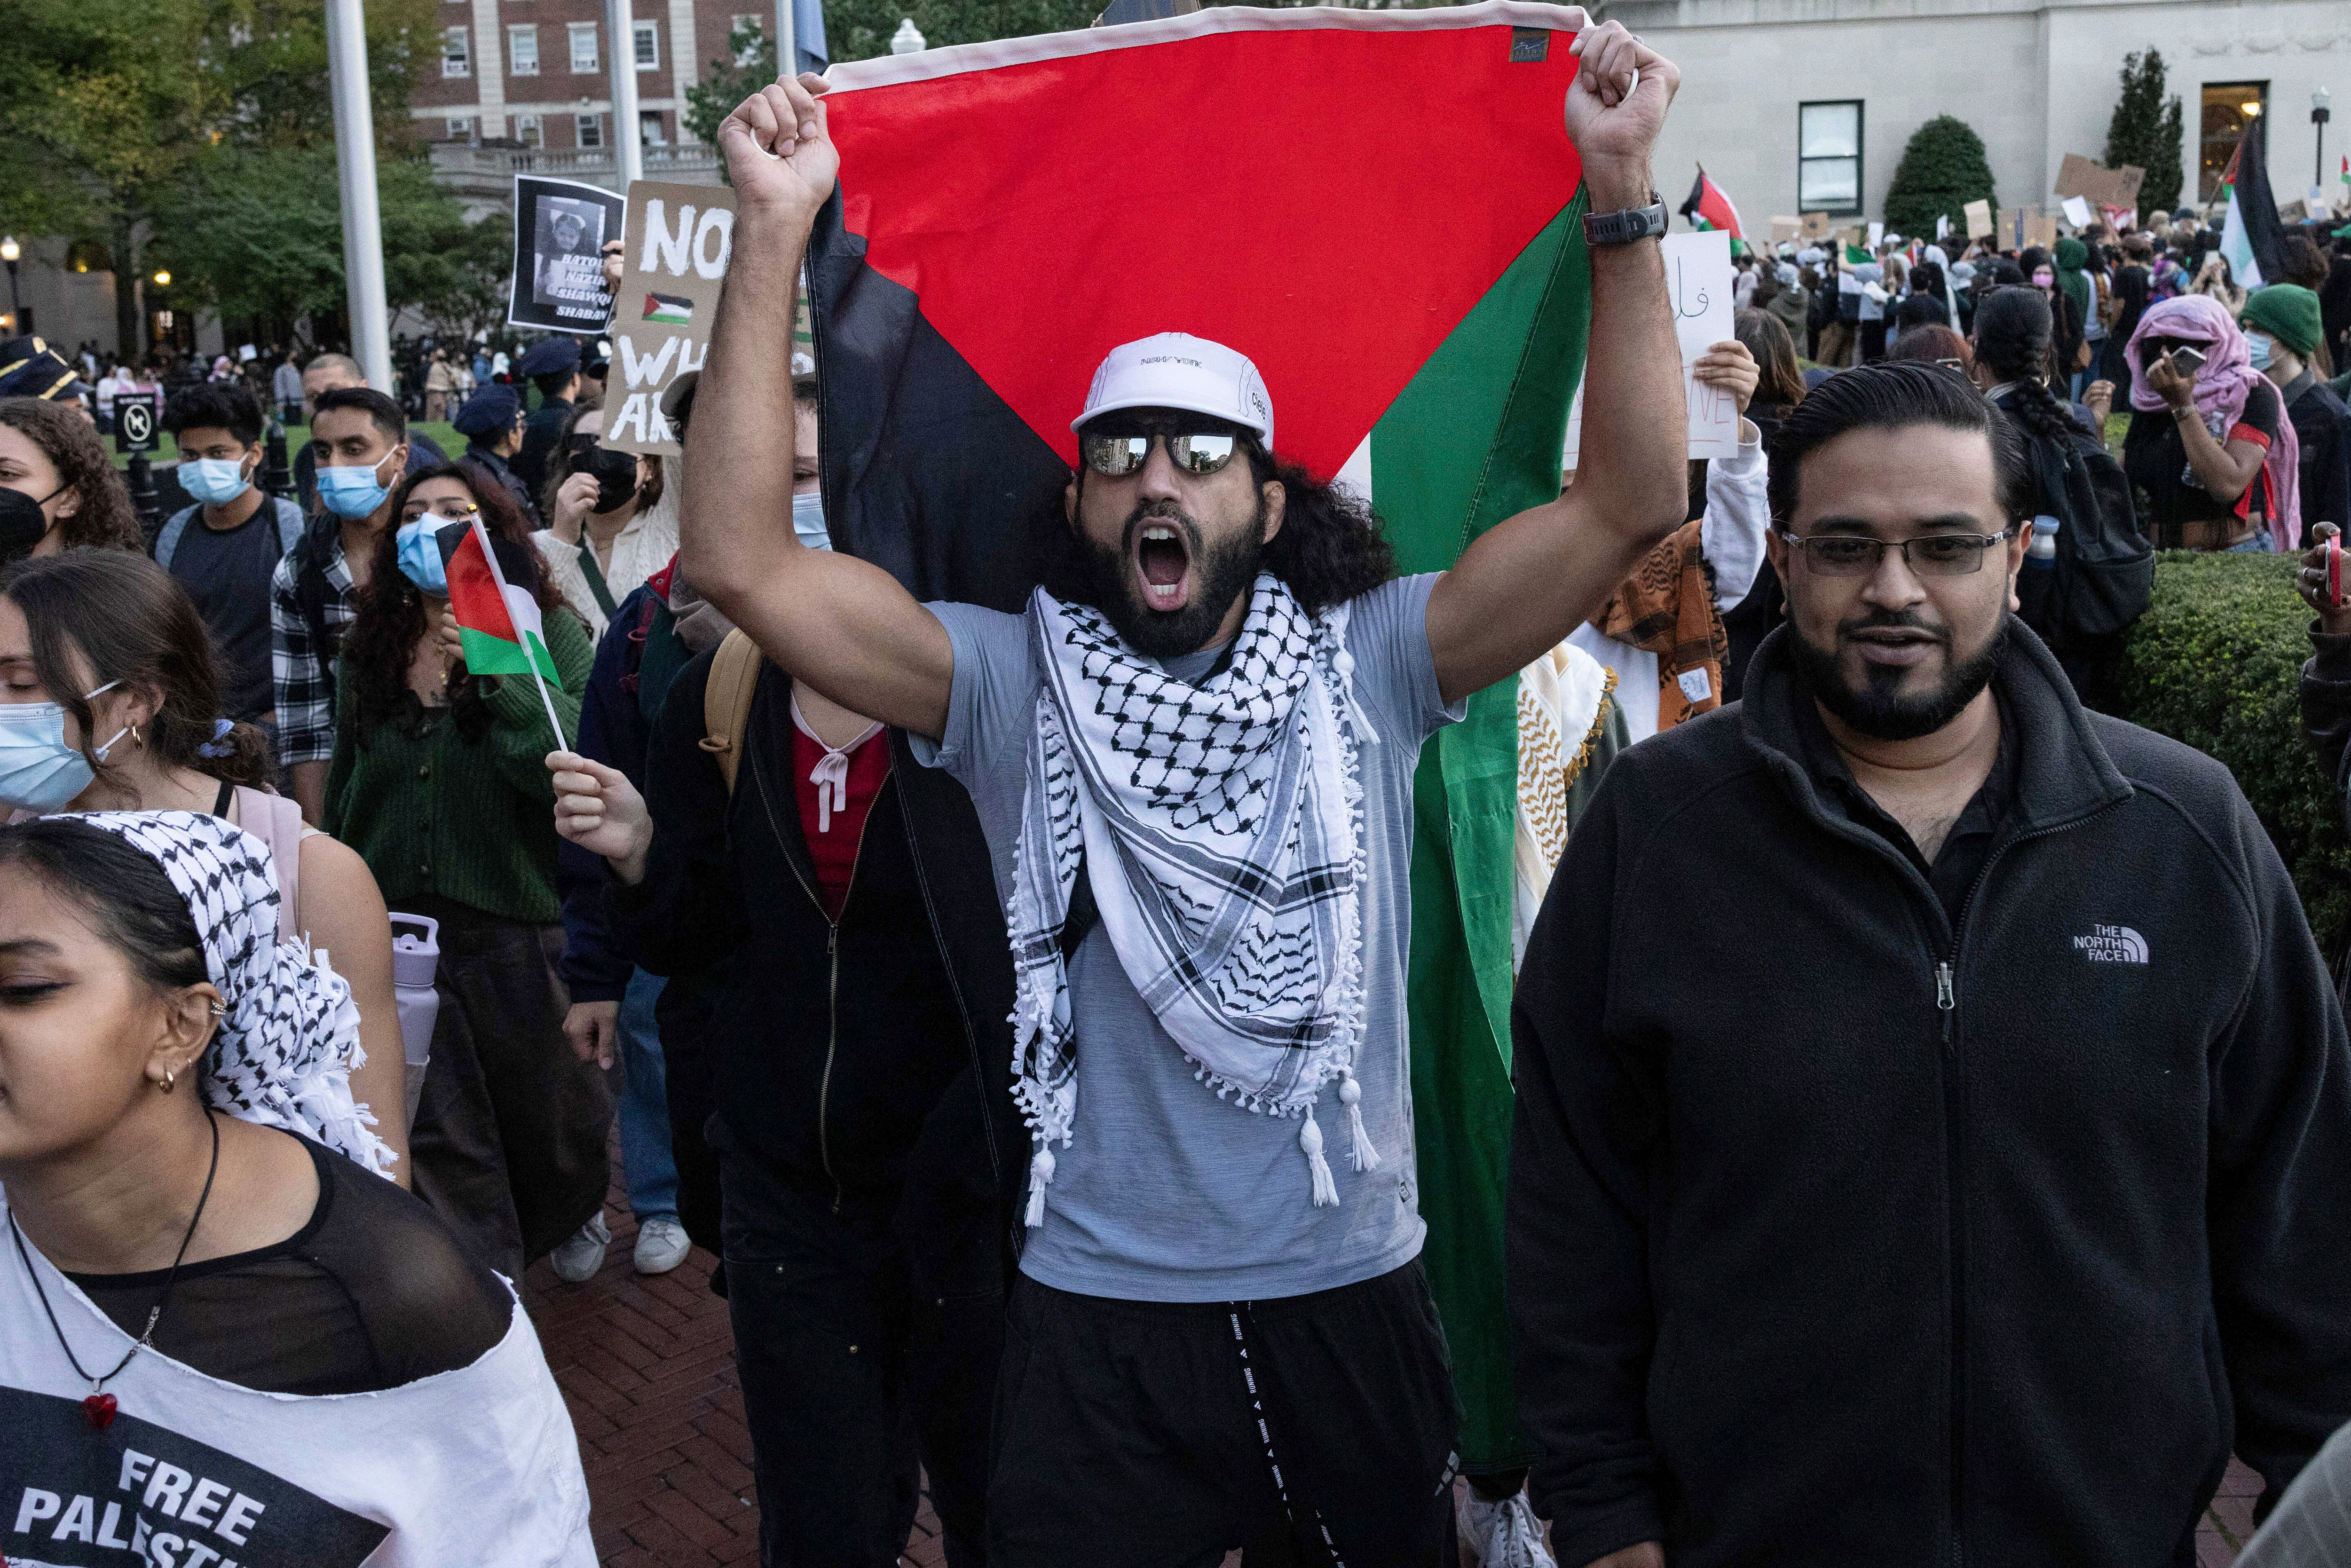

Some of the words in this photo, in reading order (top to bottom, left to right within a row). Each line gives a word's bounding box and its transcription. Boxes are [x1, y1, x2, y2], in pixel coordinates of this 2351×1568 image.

[639, 198, 734, 279] NO
[556, 306, 608, 320] SHABAN
[2074, 936, 2122, 950] NORTH
[2094, 924, 2121, 938] THE
[2088, 948, 2122, 961] FACE
[1231, 1314, 1243, 1340] RUNNING
[1244, 1368, 1256, 1394] RUNNING
[1258, 1418, 1270, 1443] RUNNING
[1272, 1465, 1284, 1489] RUNNING
[118, 1448, 265, 1546] FREE
[14, 1487, 248, 1568] PALEST
